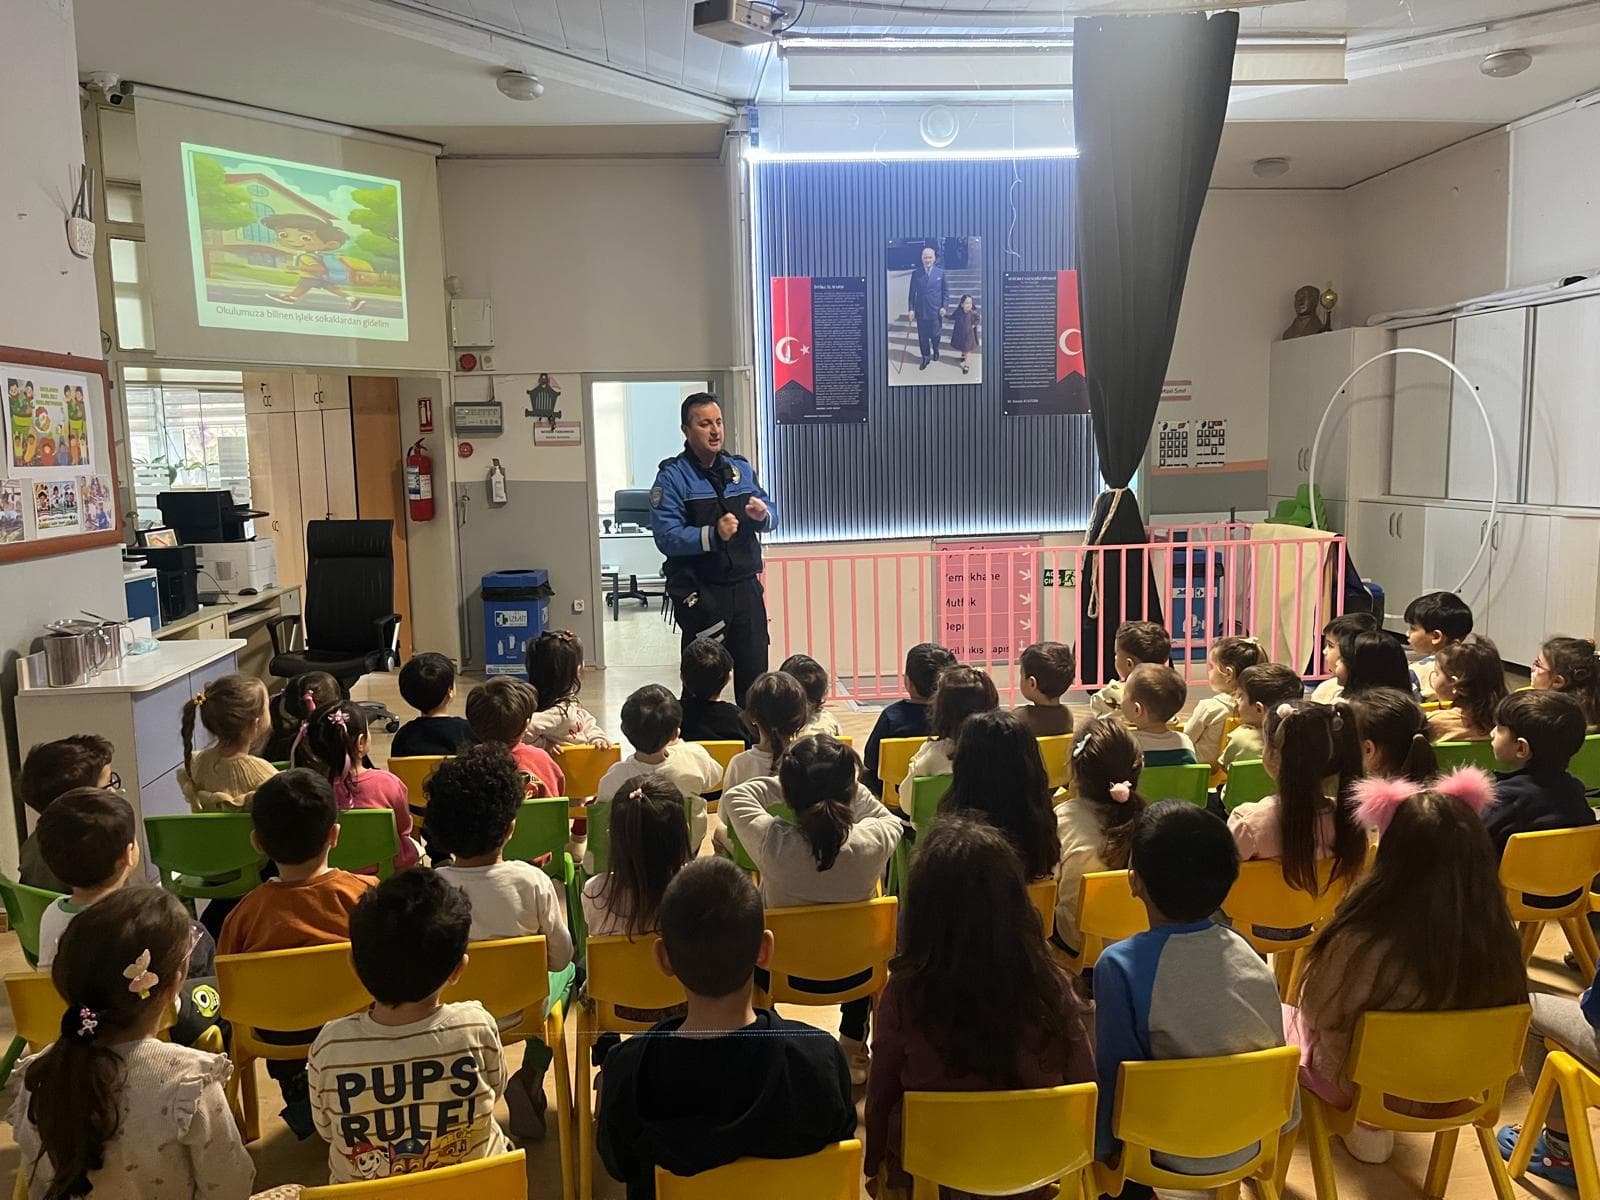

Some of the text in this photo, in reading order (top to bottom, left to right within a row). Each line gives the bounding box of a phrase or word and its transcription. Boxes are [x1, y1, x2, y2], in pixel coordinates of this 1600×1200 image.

[216, 305, 265, 318] Okulumuza
[945, 572, 1001, 583] emkhane
[336, 1056, 479, 1114] PUPS
